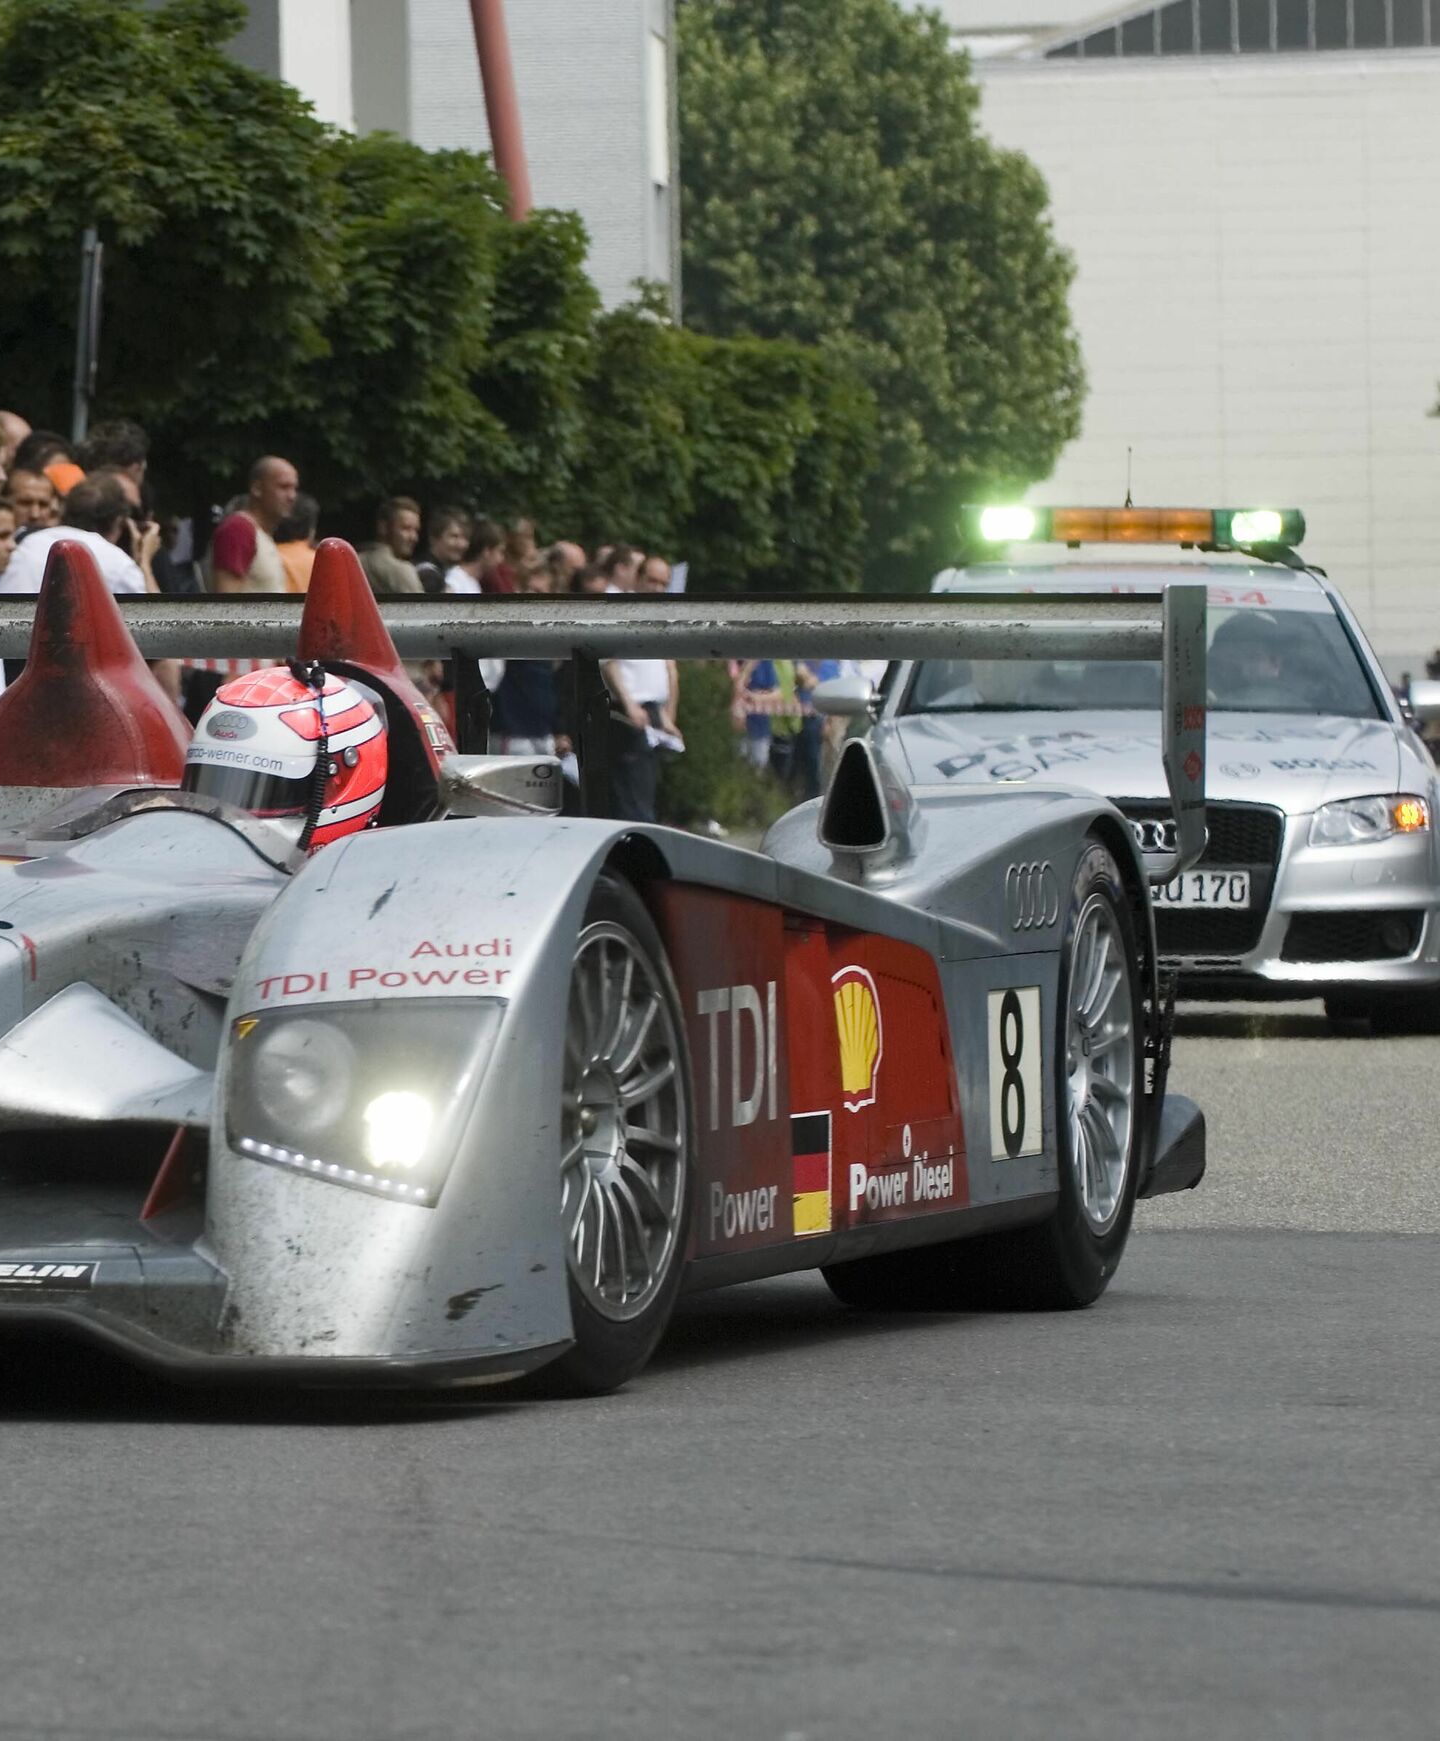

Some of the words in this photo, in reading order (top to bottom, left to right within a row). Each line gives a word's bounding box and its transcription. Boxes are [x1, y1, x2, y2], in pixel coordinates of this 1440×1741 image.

[187, 746, 283, 771] arco-werner.com
[1192, 875, 1246, 902] 170
[410, 939, 513, 958] Audi
[257, 970, 328, 1000] TDI
[348, 968, 512, 990] Power
[696, 980, 778, 1132] TDI
[999, 988, 1025, 1159] 8
[848, 1161, 908, 1211] Power
[912, 1145, 955, 1200] Diesel
[709, 1183, 778, 1241] Power
